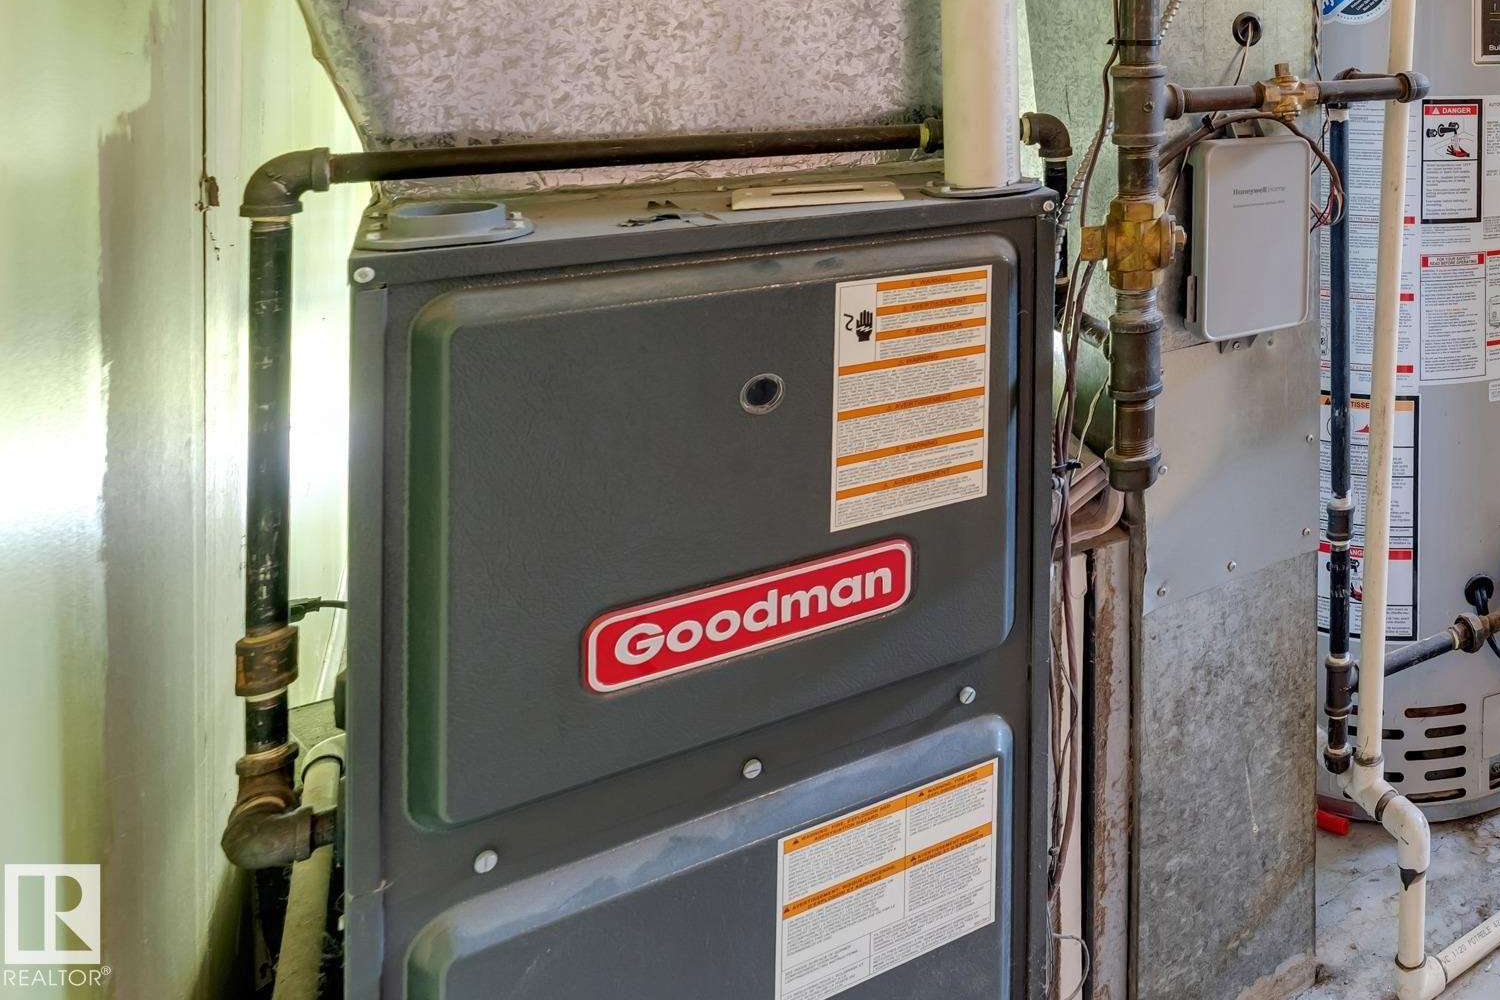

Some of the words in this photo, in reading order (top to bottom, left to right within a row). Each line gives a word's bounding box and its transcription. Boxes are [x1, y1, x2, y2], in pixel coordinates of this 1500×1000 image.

[1233, 186, 1267, 195] Honeywell
[919, 275, 951, 285] WARNING
[911, 297, 966, 310] AVERTISSEMENT
[915, 321, 962, 334] ADVERTENCIA
[906, 353, 938, 364] WARNING
[895, 393, 951, 410] AVERTISSEMENT
[905, 438, 938, 451] WARNING
[893, 467, 950, 487] AVERTISSEMENT
